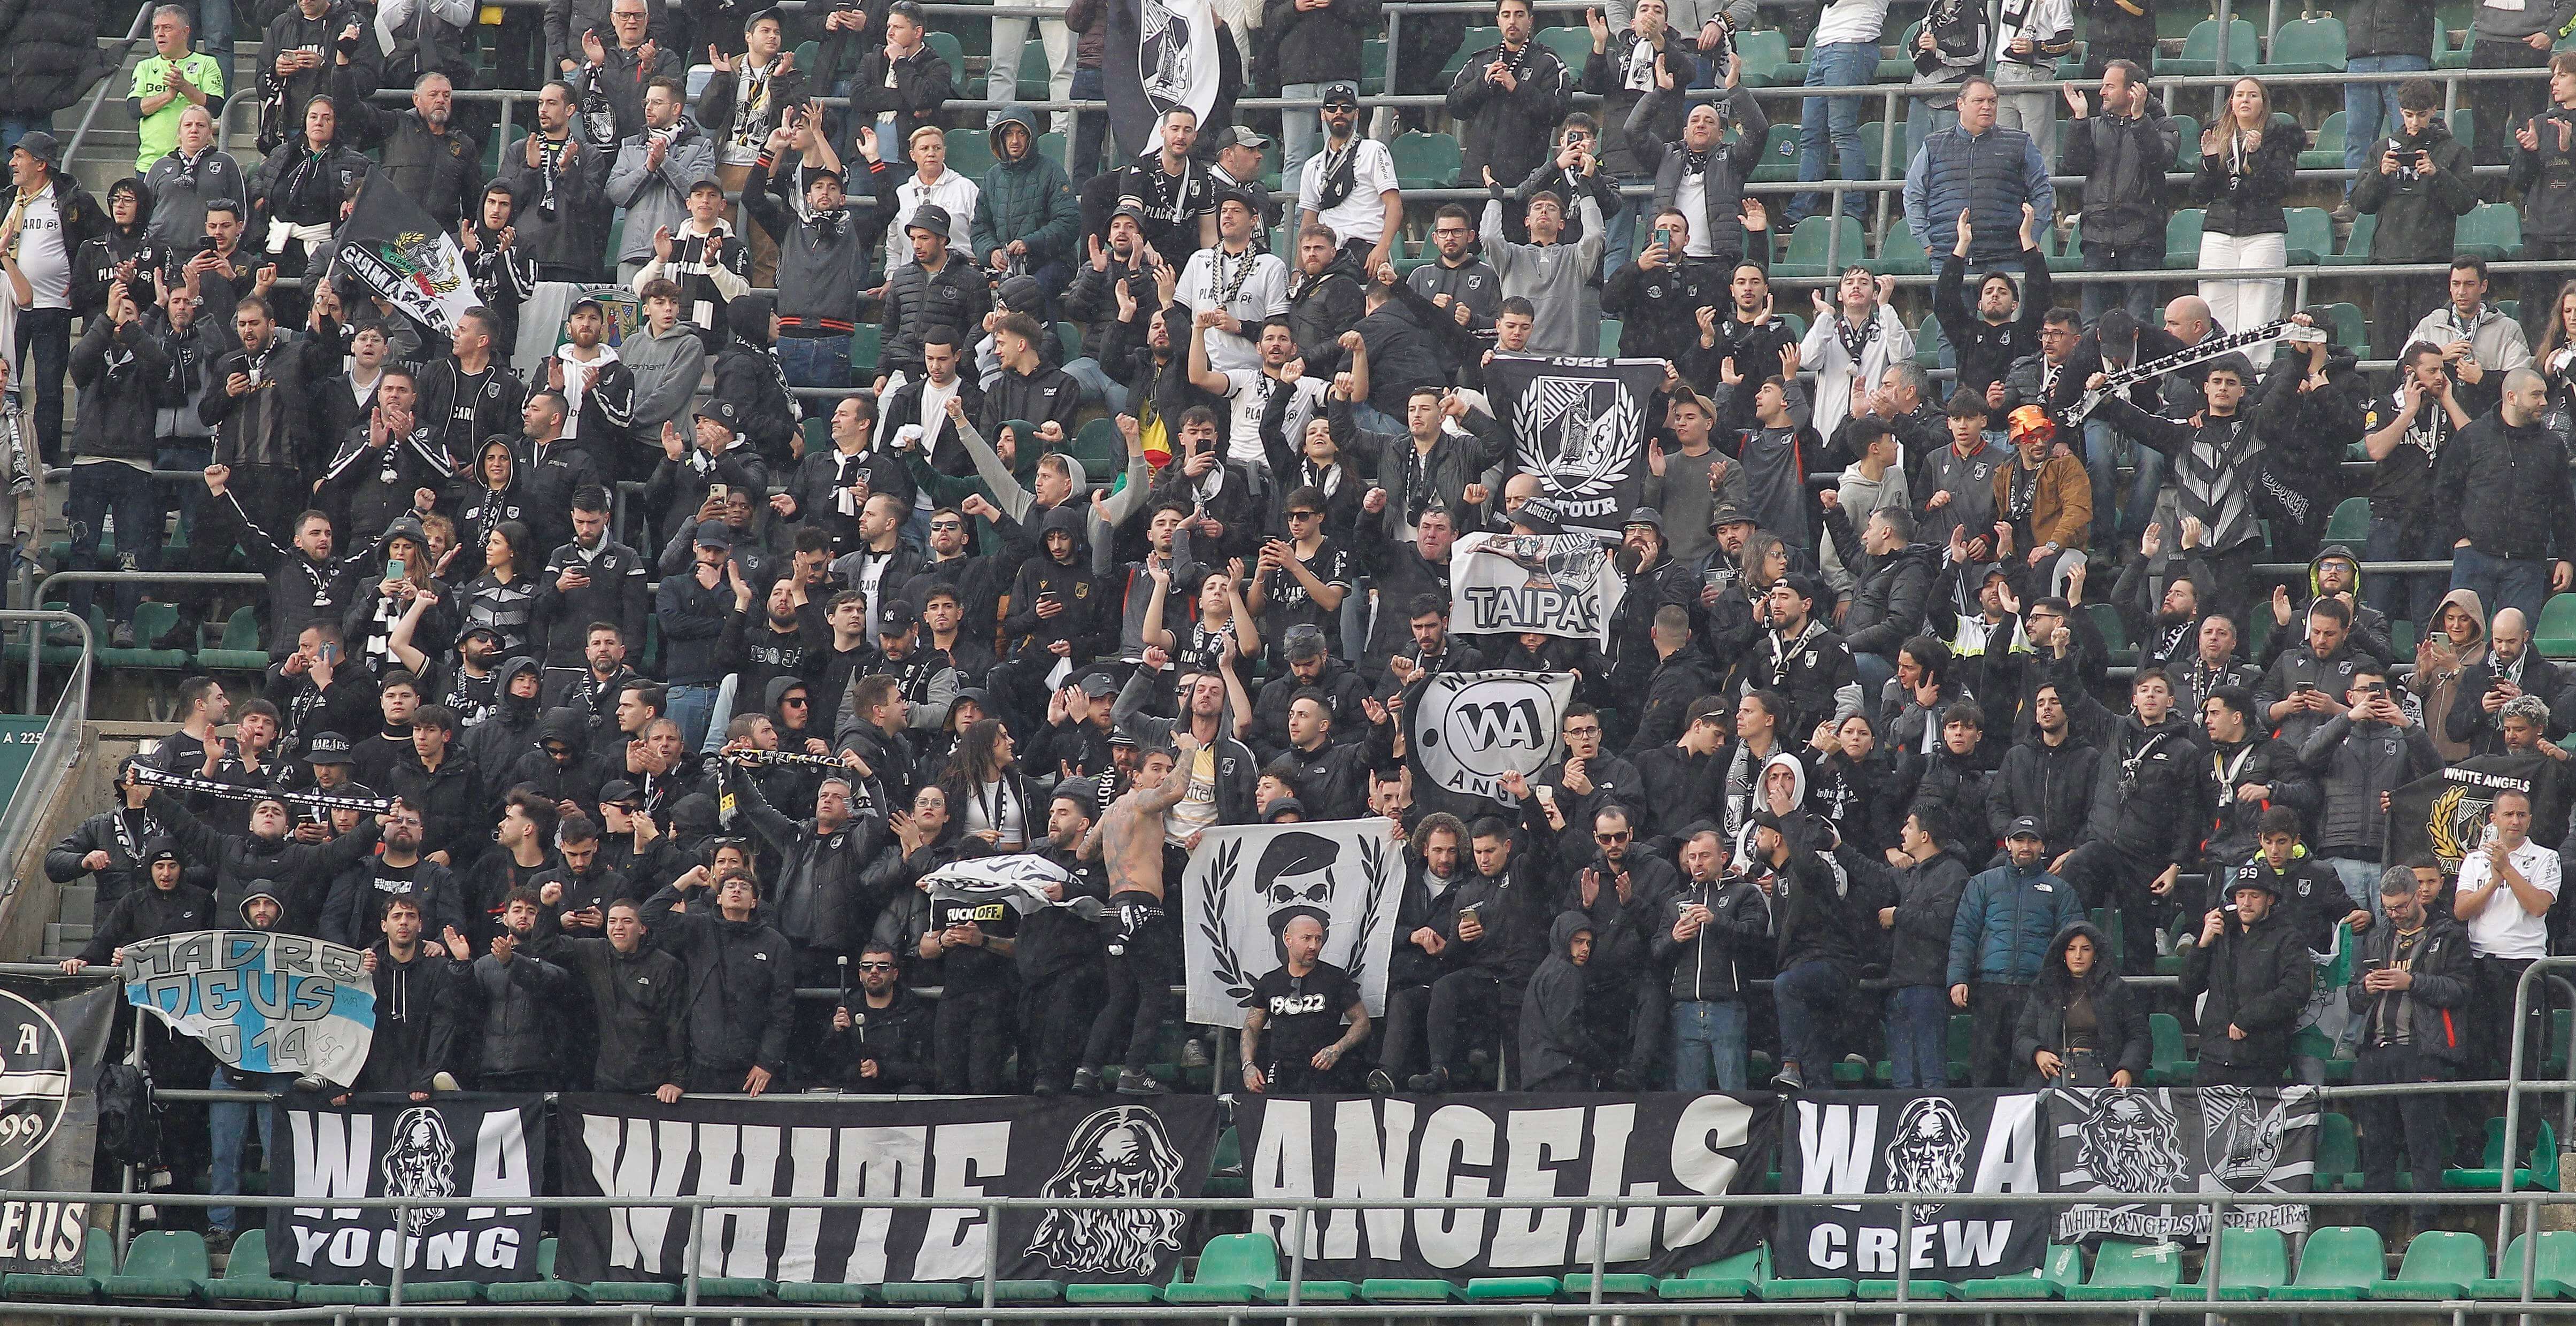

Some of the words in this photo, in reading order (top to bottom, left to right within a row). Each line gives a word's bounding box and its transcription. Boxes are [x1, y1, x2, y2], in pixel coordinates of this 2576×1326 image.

[391, 255, 418, 275] CIDADE
[465, 507, 480, 519] 99
[1525, 502, 1559, 524] ANGELS
[3, 733, 13, 744] A
[20, 733, 43, 744] 225
[139, 768, 230, 790] WHITE
[283, 792, 388, 808] ANGELS
[2444, 767, 2482, 787] WHITE
[2484, 769, 2532, 793] ANGELS
[2239, 867, 2258, 880] 99
[947, 908, 975, 921] FUCK
[977, 907, 1000, 919] OFF.
[126, 932, 363, 983] MADRE
[146, 970, 337, 1020] DEUS
[14, 1023, 40, 1054] A
[288, 1110, 373, 1221] W
[466, 1107, 533, 1220] A
[1797, 1100, 1879, 1211] W
[1973, 1093, 2038, 1193] A
[582, 1113, 1012, 1285] WHITE
[1251, 1093, 1753, 1270] ANGELS
[0, 1201, 84, 1261] EUS
[2062, 1207, 2115, 1235] WHITE
[2117, 1215, 2193, 1238] ANGELS
[2197, 1206, 2309, 1232] NSPEREIRA
[290, 1224, 521, 1271] YOUNG
[1808, 1219, 2014, 1273] CREW
